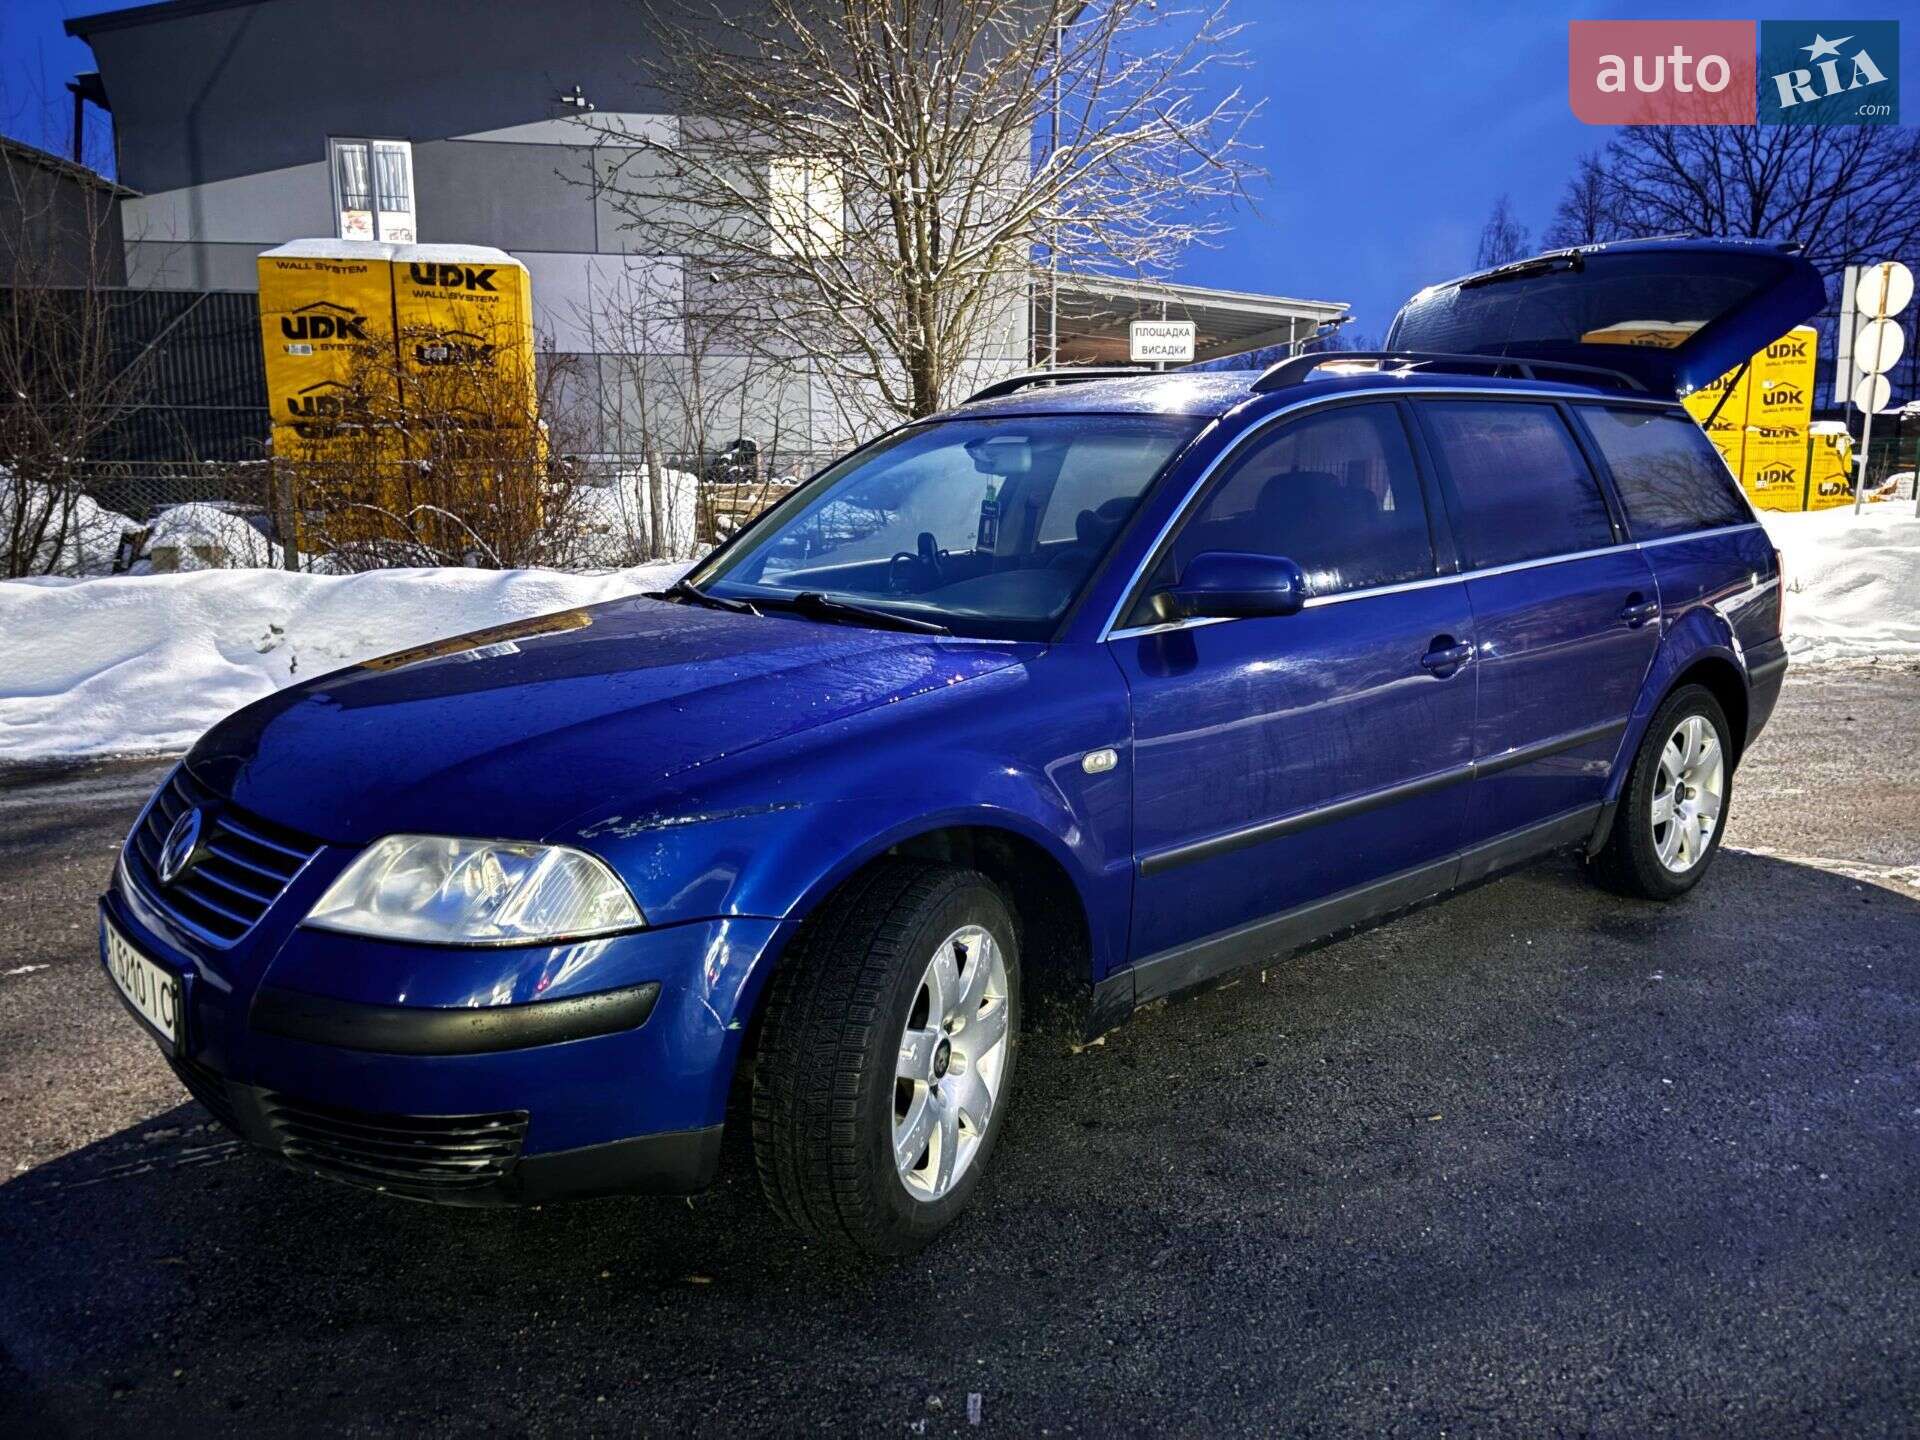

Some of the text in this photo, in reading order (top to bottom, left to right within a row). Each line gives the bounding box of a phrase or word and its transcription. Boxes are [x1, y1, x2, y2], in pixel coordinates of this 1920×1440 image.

[276, 261, 368, 274] WALL SYSTEM
[410, 262, 498, 292] UDK
[413, 290, 499, 303] WALL SYSTEM
[281, 315, 369, 340] UDK
[1135, 327, 1191, 338] ПЛОЩАДКА
[1141, 345, 1187, 355] ВИСАДКИ
[1765, 342, 1808, 359] UDK
[1762, 390, 1804, 406] UDK
[1757, 469, 1796, 484] UDK
